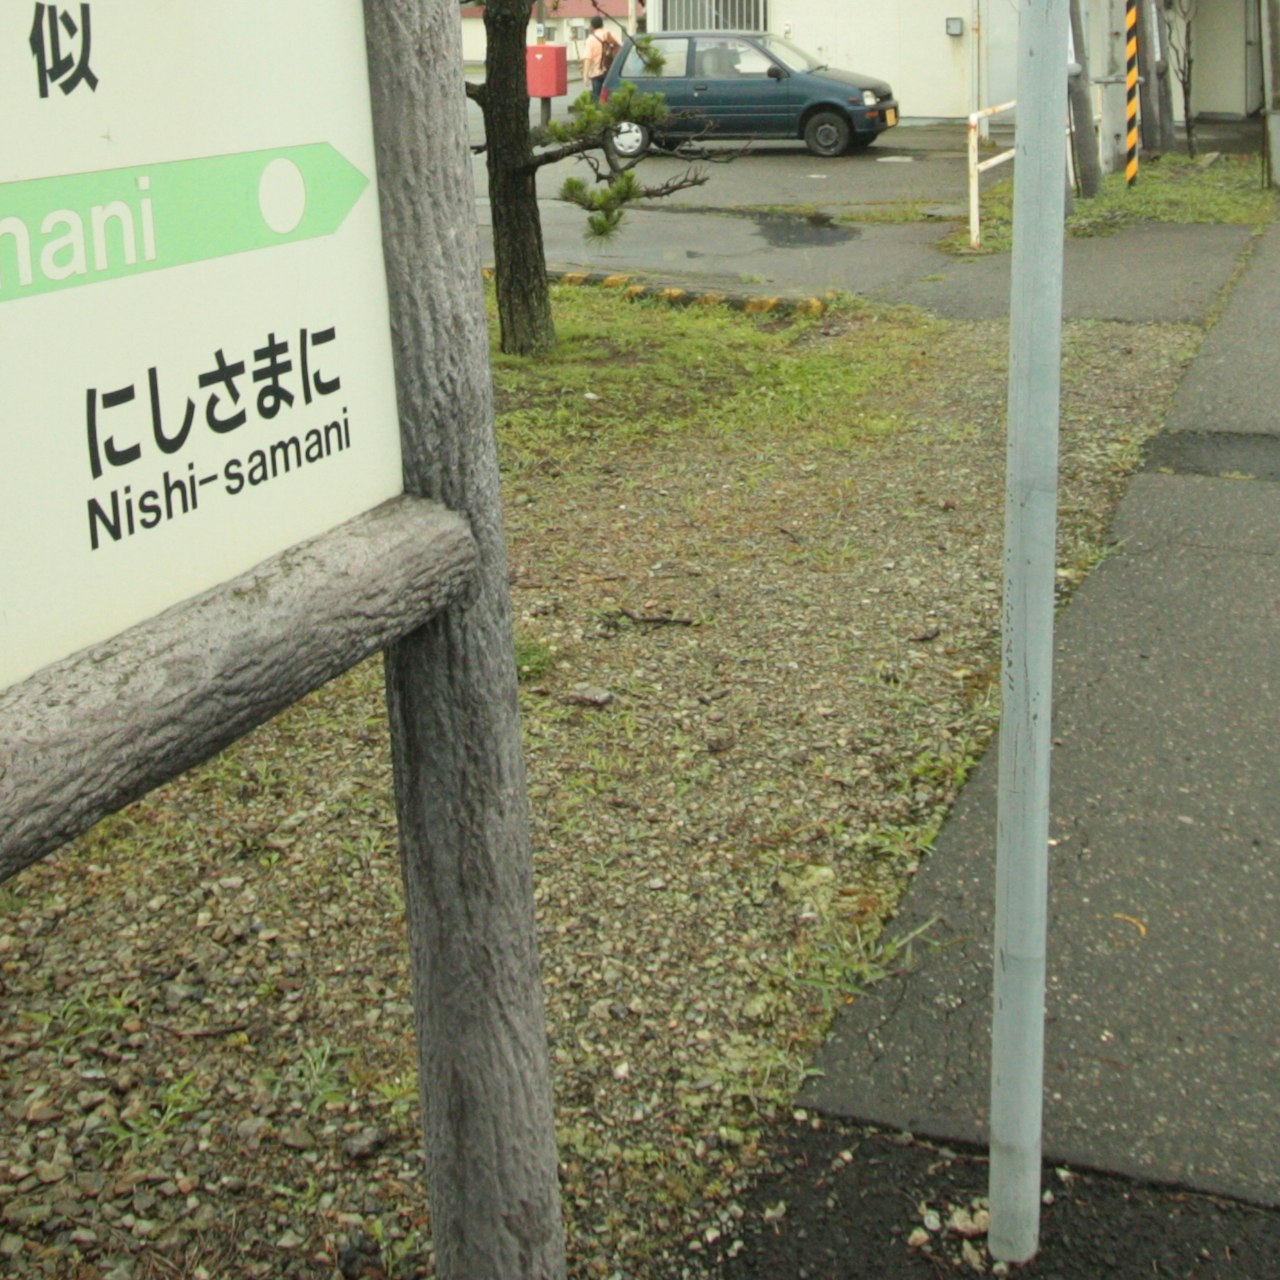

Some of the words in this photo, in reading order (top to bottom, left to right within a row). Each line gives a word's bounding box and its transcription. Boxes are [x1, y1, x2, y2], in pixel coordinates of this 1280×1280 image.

[86, 326, 341, 480] にしさまに
[87, 406, 351, 551] Nishi-samani
